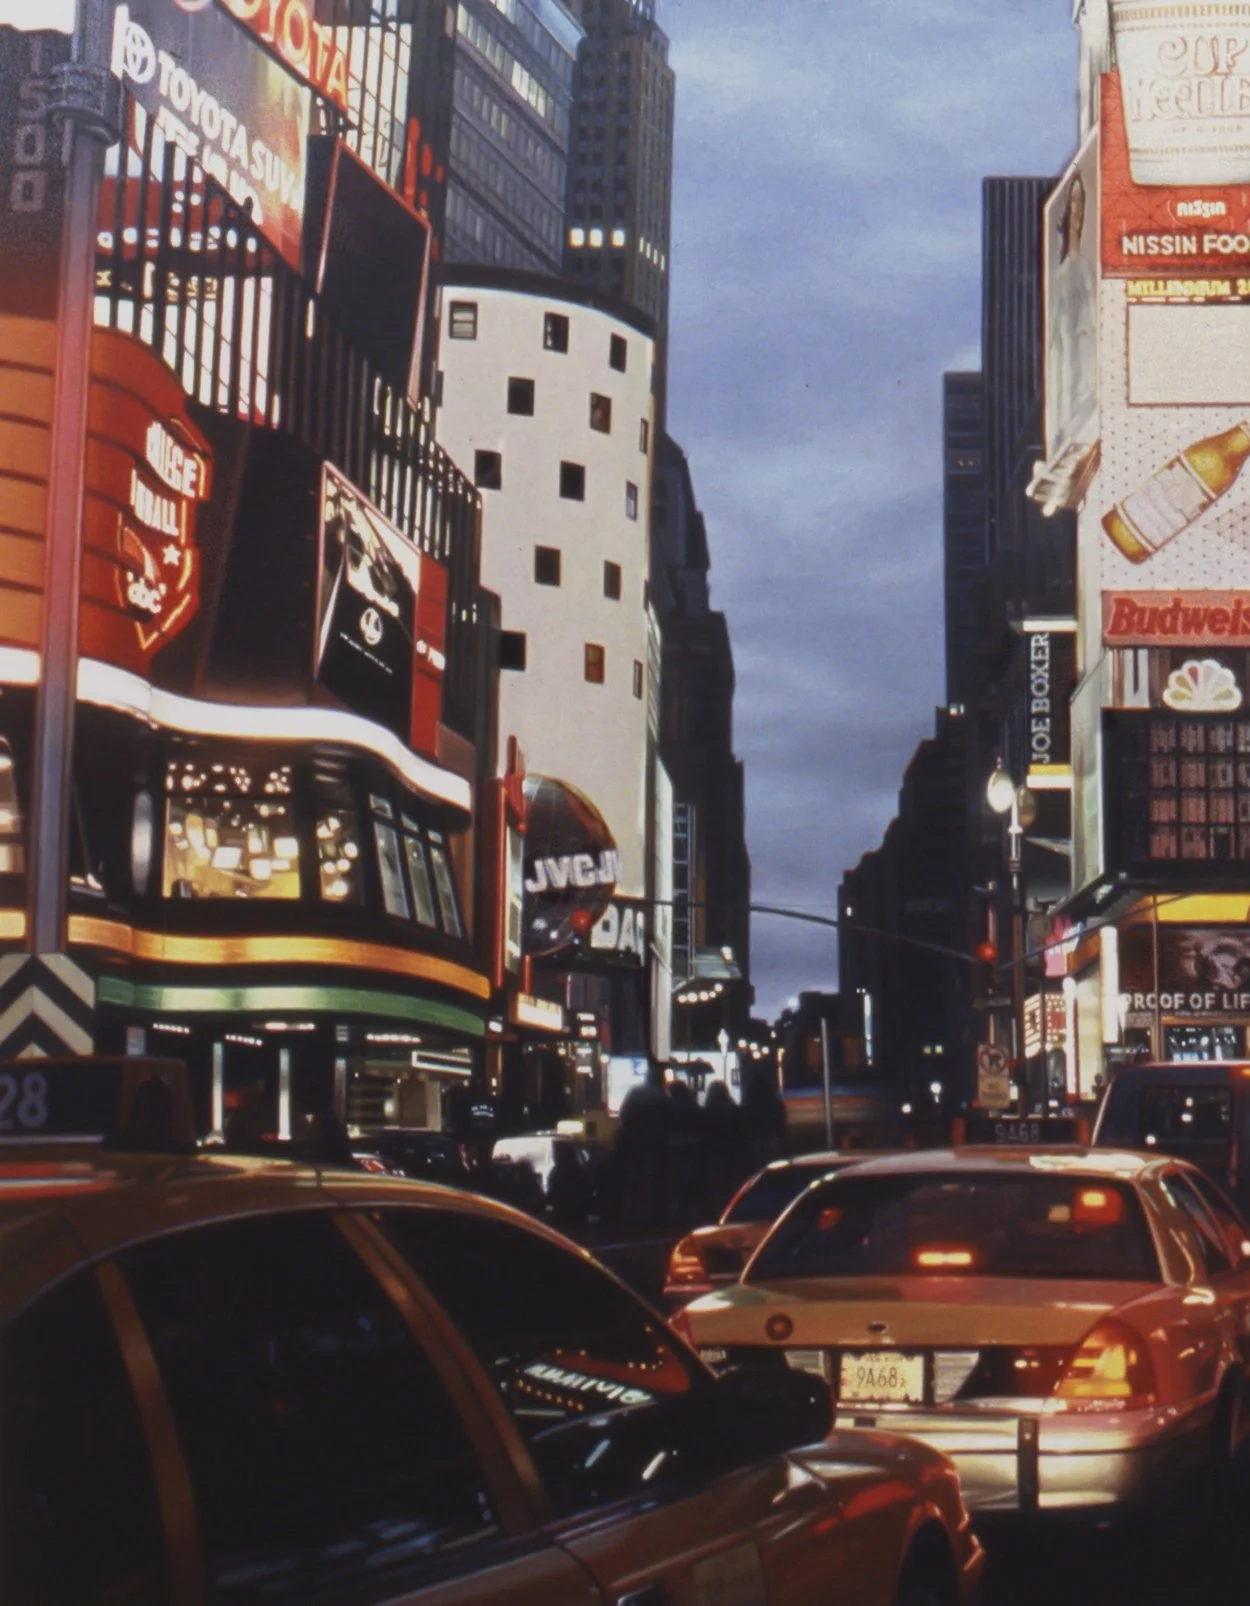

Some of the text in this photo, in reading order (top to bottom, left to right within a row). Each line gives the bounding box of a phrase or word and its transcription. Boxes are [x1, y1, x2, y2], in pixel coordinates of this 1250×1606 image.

[1158, 35, 1249, 77] CUP
[157, 50, 249, 169] TOYOTA
[1122, 234, 1197, 255] NISSIN
[1030, 632, 1051, 765] JOE BOXER
[1119, 993, 1185, 1010] PROOF
[1189, 993, 1216, 1010] OF
